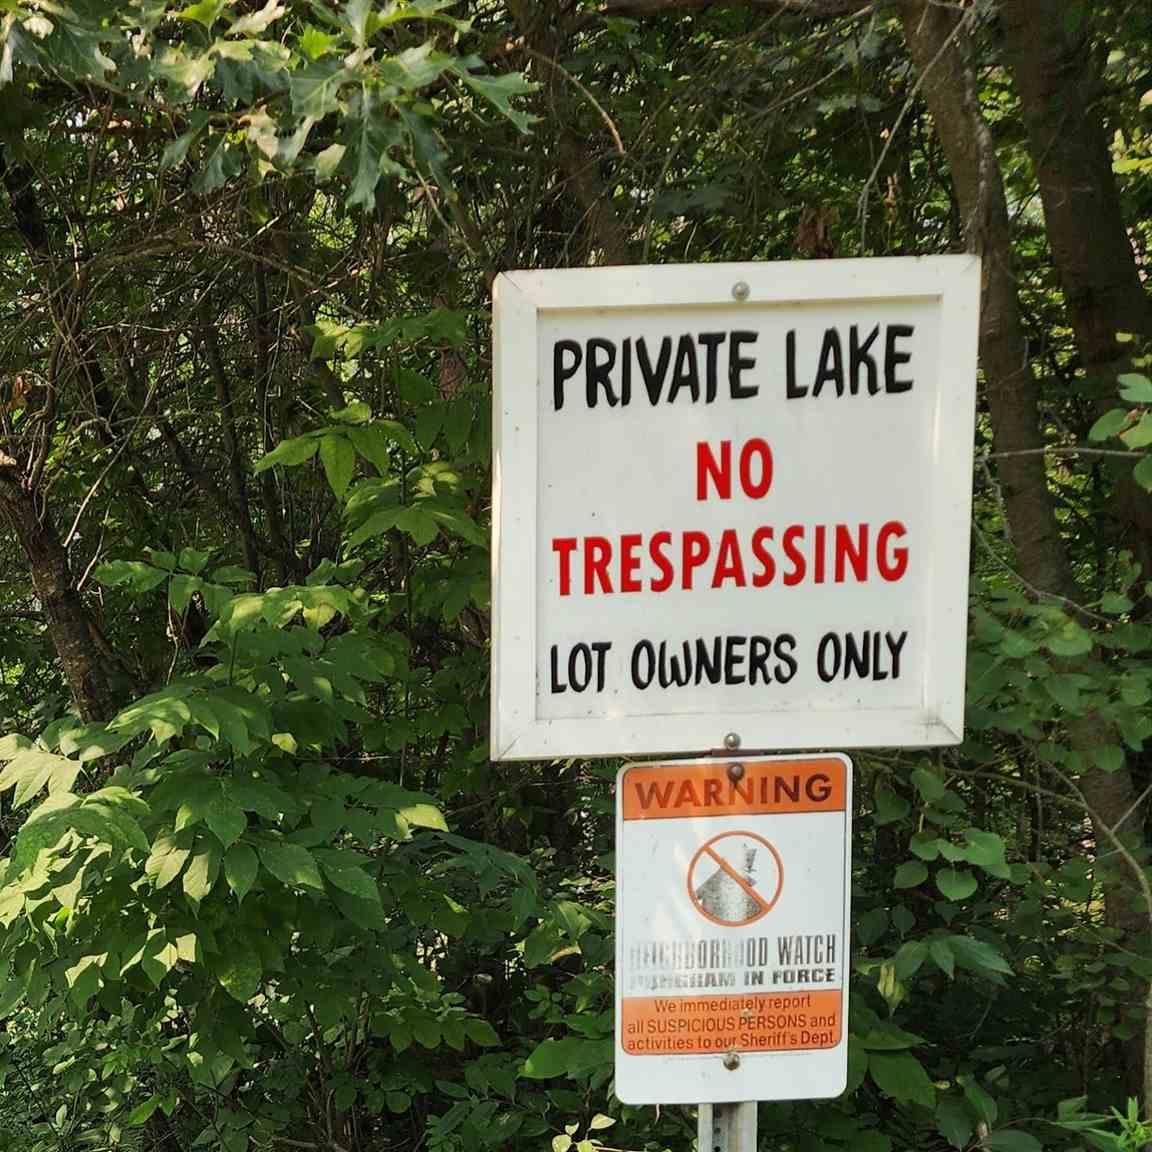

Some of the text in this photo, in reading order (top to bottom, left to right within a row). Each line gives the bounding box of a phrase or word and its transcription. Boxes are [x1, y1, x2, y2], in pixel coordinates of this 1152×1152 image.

[553, 321, 915, 411] PRIVATE LAKE
[696, 437, 773, 501] NO
[552, 520, 910, 597] TRESPASSING
[550, 630, 908, 695] LOT OWNERS ONLY
[635, 774, 832, 810] WARNING
[777, 933, 836, 966] WATCH
[630, 968, 835, 990] GRAM IN FORCE
[654, 994, 811, 1013] We immediately report
[628, 1012, 836, 1034] all SUSPICIOUS PERSONS and
[628, 1036, 694, 1051] activities
[697, 1036, 712, 1049] to
[715, 1036, 738, 1048] our
[740, 1032, 798, 1048] Sheriff's
